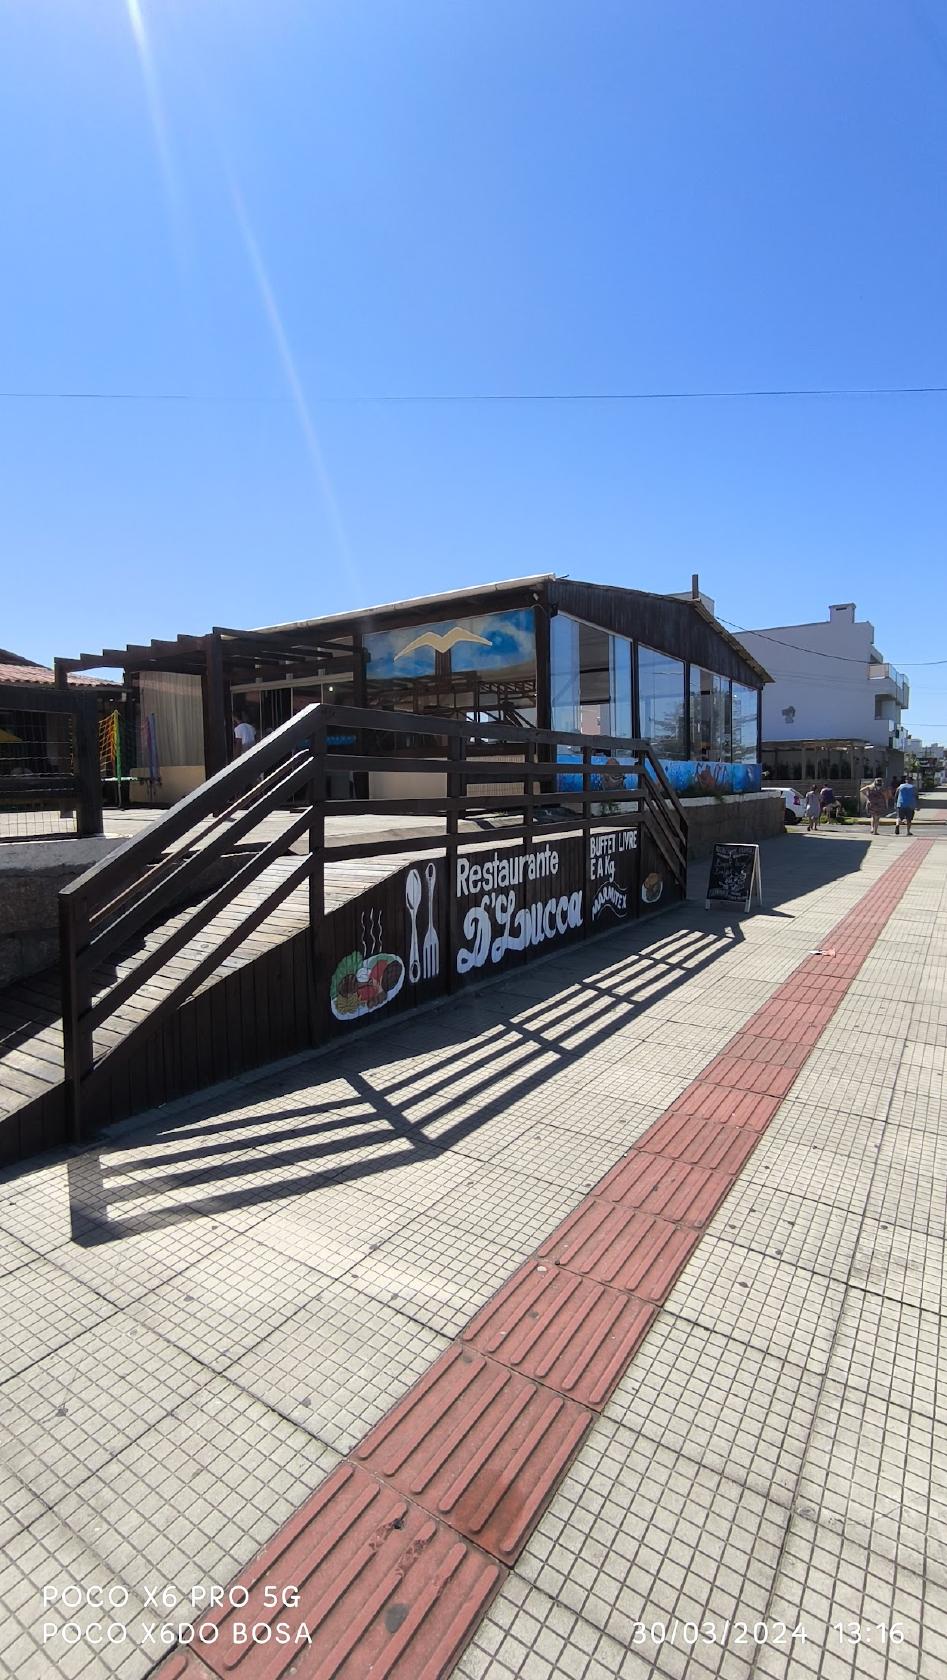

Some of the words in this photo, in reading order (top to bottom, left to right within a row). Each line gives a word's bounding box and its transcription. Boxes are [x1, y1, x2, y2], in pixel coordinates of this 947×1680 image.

[590, 834, 616, 858] BUFFET
[618, 830, 638, 852] LIVRE
[456, 843, 559, 898] Restaurante
[590, 858, 596, 880] E
[597, 857, 604, 878] A
[456, 890, 583, 974] D'Lucca
